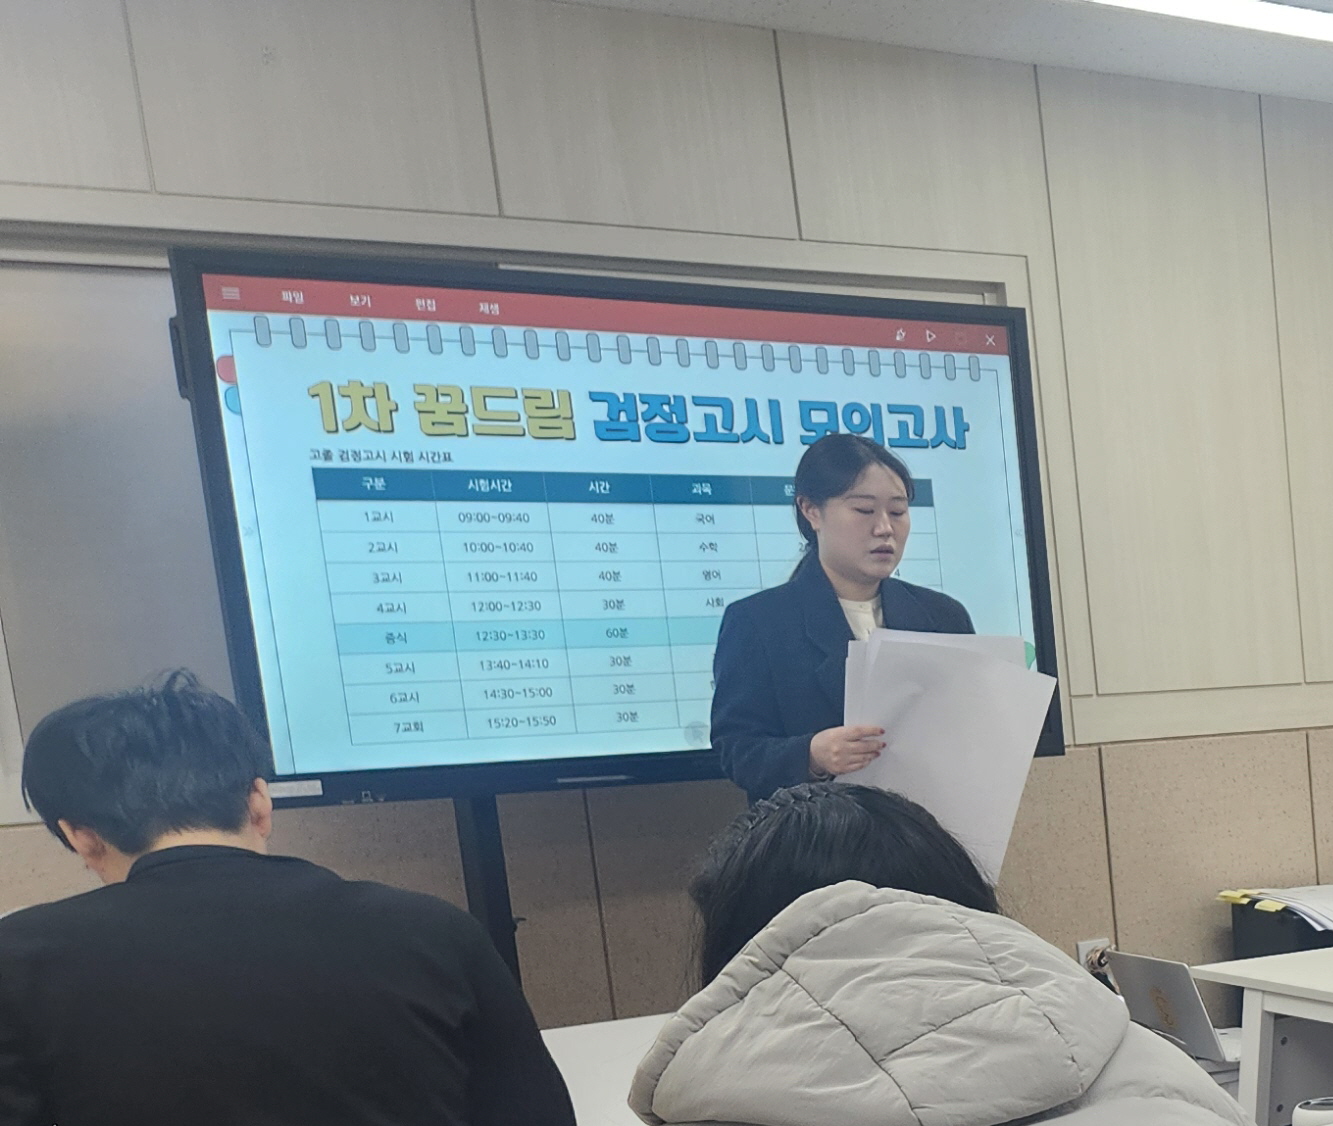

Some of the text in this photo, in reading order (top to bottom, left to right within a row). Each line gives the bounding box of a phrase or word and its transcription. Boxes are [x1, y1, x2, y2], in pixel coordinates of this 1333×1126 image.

[281, 290, 304, 304] 파일
[350, 295, 372, 308] 보기
[416, 298, 437, 312] 편집
[479, 301, 499, 315] 재생
[307, 380, 971, 450] 1차 꿈드림 검정고시 모의고사
[339, 449, 387, 463] 검정고시
[391, 450, 415, 463] 시험
[419, 450, 454, 464] 시간표
[362, 476, 387, 491] 구분
[467, 478, 513, 493] 시험시간
[589, 480, 611, 494] 시간
[691, 483, 713, 496] 과목
[365, 511, 394, 523] 1교시
[591, 513, 615, 525] 40분
[368, 541, 398, 554] 2교시
[595, 542, 619, 554] 40분
[372, 572, 402, 584] 3교시
[598, 570, 622, 582] 40분
[376, 602, 407, 614] 4교시
[603, 598, 626, 611] 30분
[606, 627, 629, 639] 60분
[385, 661, 415, 674] 5교시
[609, 655, 632, 667] 30분
[613, 683, 636, 695] 30분
[390, 691, 420, 704] 6교시
[616, 711, 639, 723] 30분
